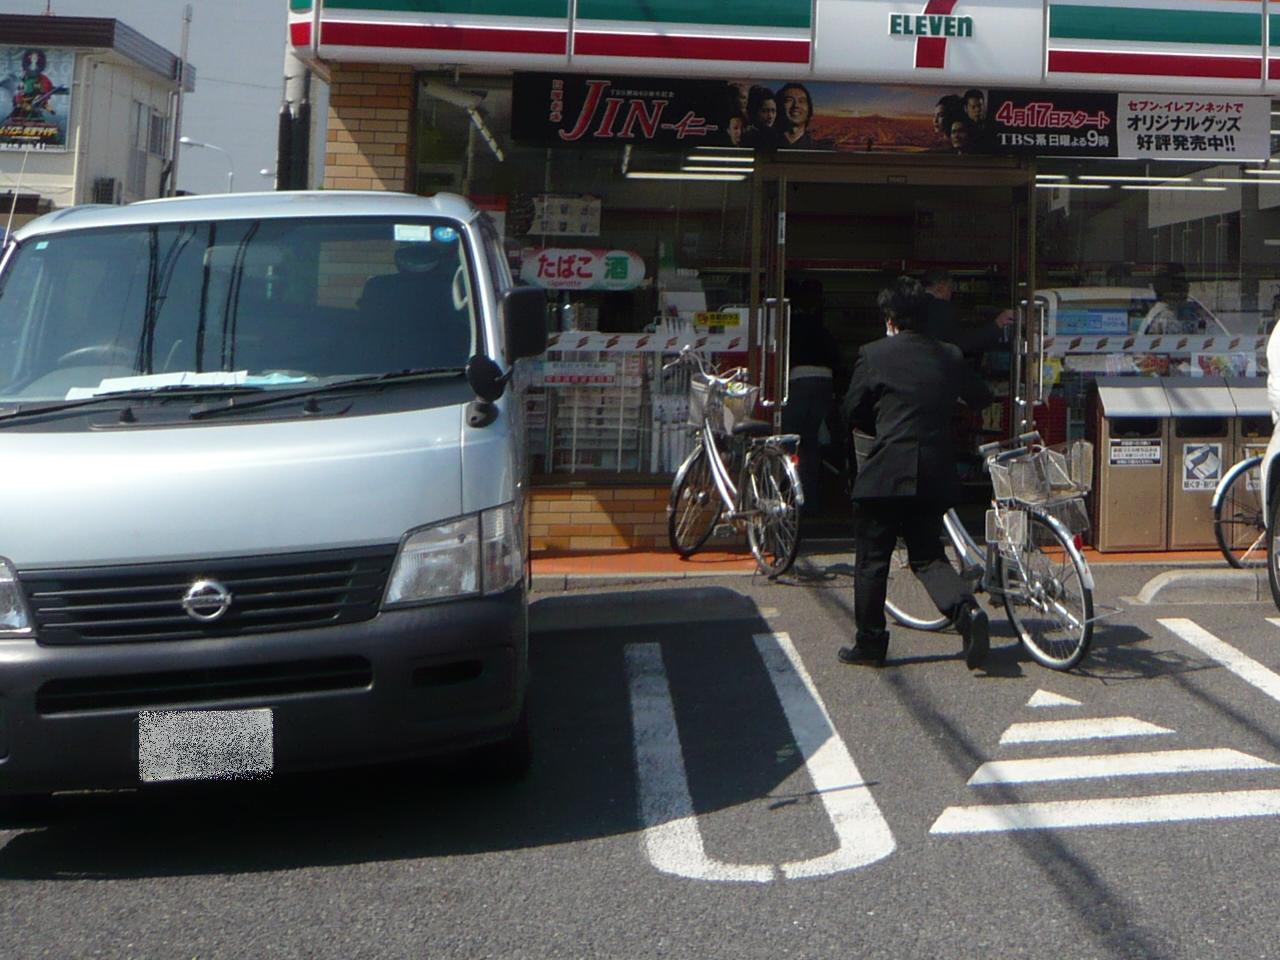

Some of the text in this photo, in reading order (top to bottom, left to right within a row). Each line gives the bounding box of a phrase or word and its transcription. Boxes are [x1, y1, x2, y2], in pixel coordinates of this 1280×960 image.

[996, 101, 1110, 129] 4月17日スタート
[1127, 115, 1242, 132] オリジナルグッズ
[537, 254, 629, 279] たばこ 酒
